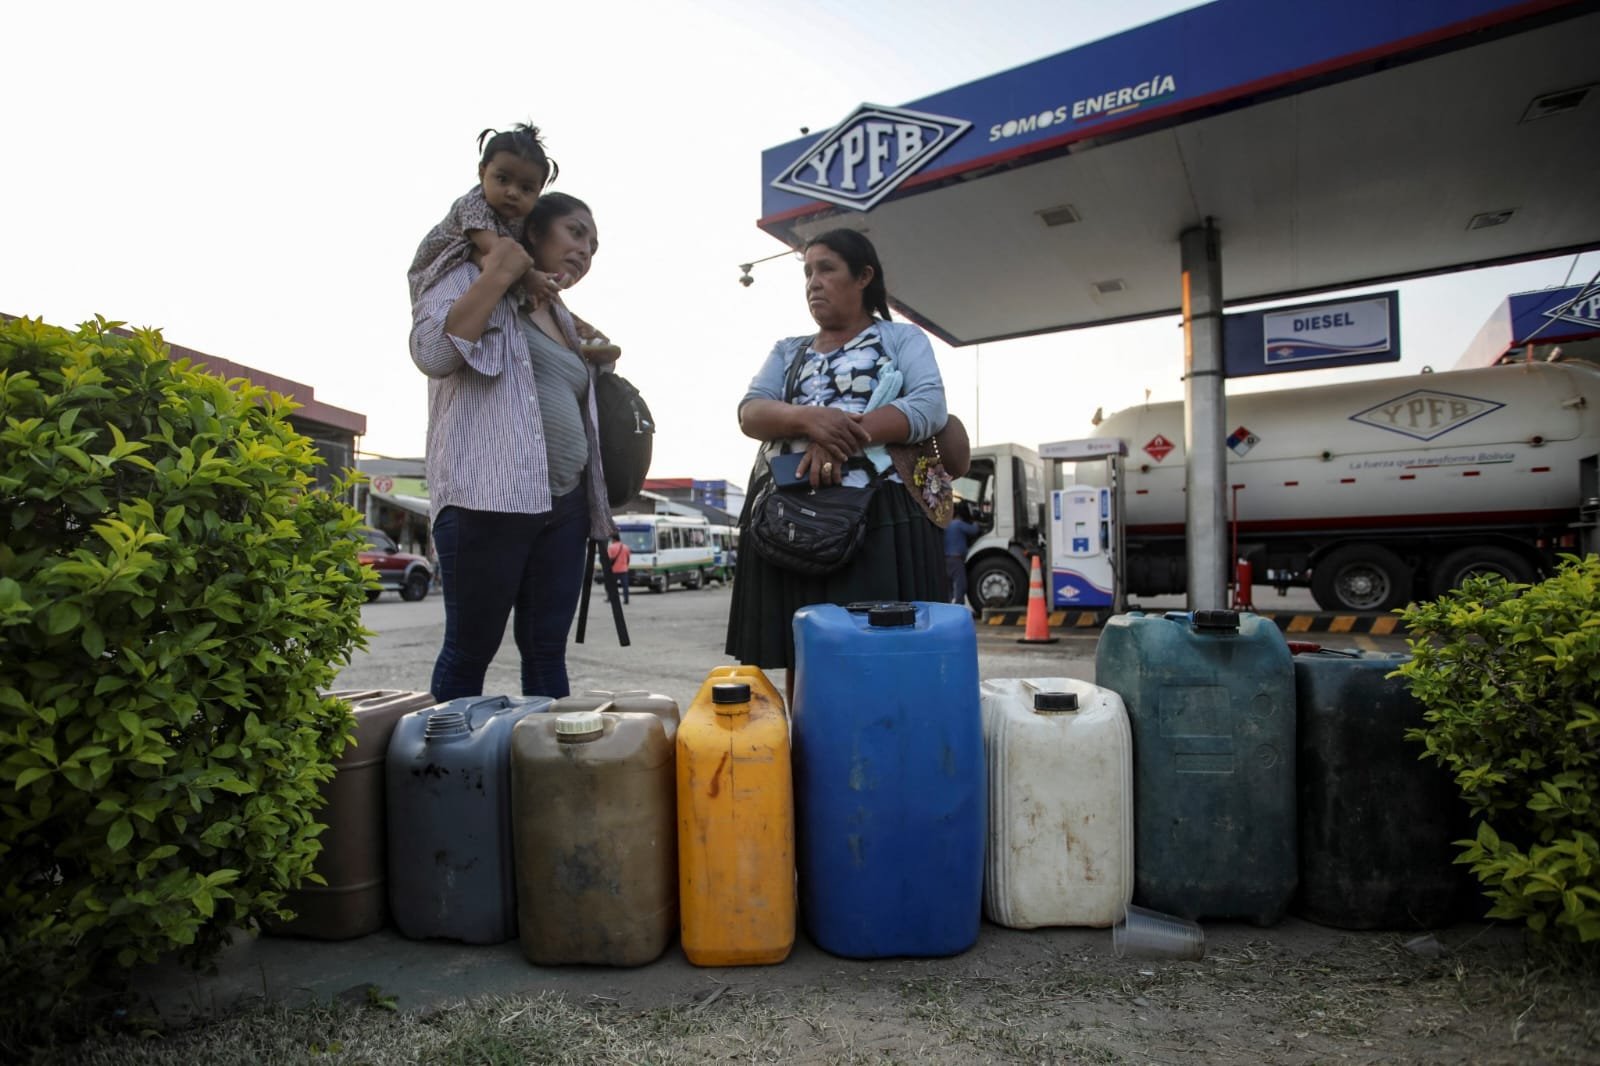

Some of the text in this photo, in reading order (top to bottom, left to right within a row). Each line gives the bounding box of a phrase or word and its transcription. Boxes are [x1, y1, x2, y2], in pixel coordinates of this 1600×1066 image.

[989, 75, 1176, 142] SOMOS ENERGÍA
[807, 122, 923, 190] YPFB
[1293, 311, 1355, 333] DIESEL
[1383, 398, 1468, 428] YPFB
[1350, 462, 1361, 470] La
[1363, 459, 1394, 469] fuerza
[1417, 454, 1476, 466] transforma
[1477, 452, 1516, 462] Bolivia
